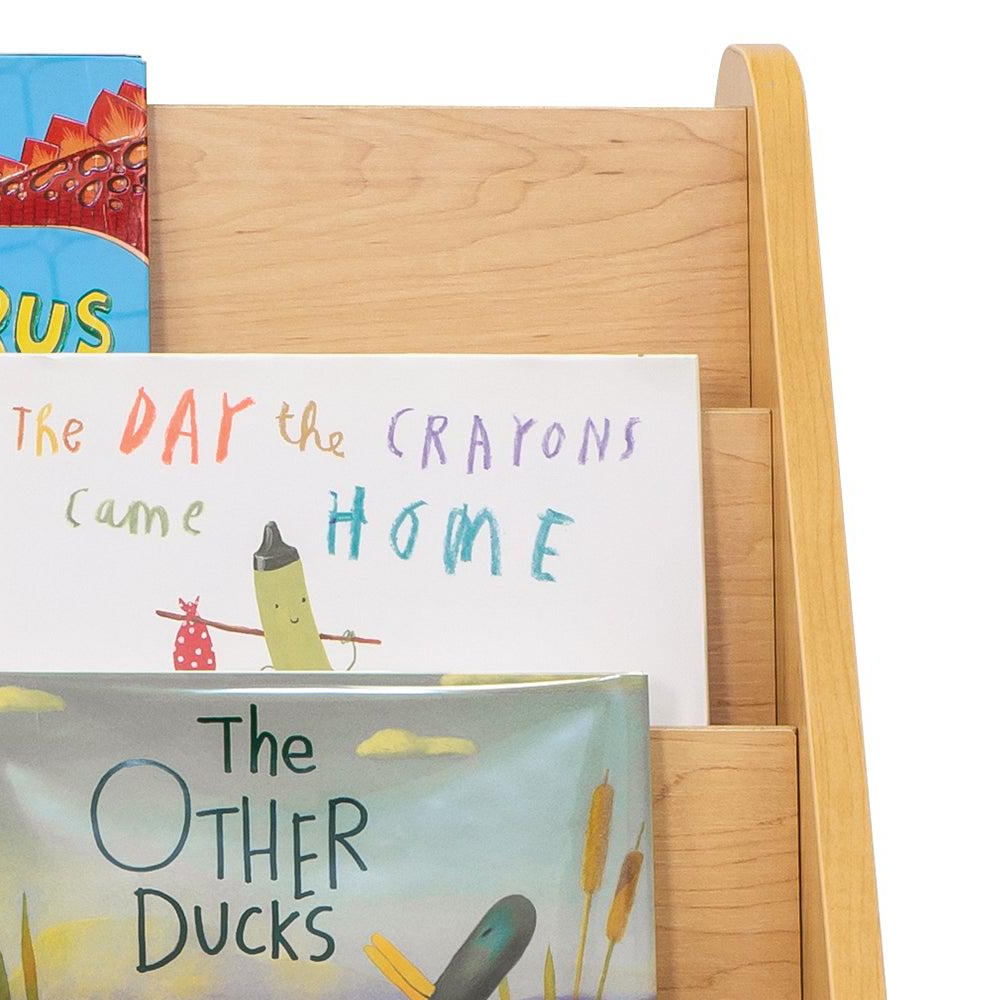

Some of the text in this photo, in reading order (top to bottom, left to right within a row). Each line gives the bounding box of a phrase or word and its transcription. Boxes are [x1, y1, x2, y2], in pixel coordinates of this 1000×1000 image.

[11, 387, 642, 474] The DAY the CRAYONS
[327, 485, 575, 583] HOME
[197, 704, 316, 776] The
[90, 758, 368, 900] OTHER
